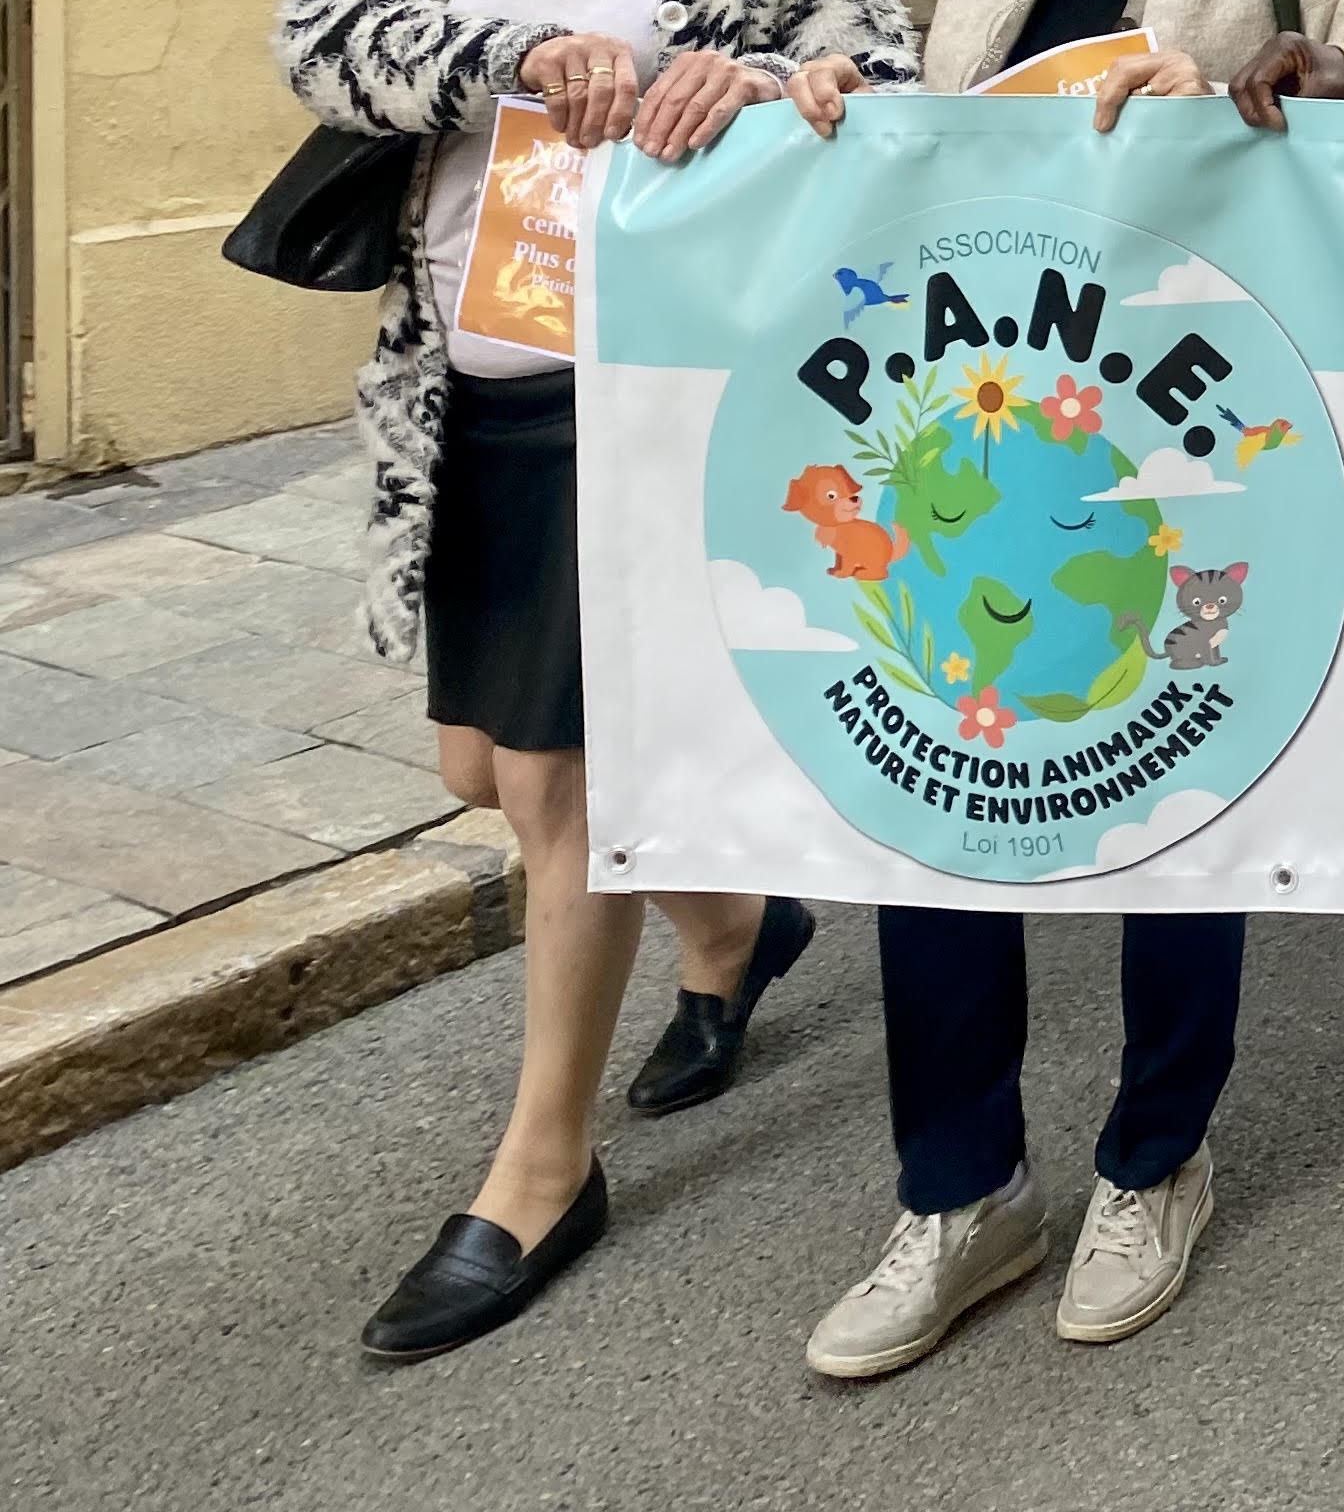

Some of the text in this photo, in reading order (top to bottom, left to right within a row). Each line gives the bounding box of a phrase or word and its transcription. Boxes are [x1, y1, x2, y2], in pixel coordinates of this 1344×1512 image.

[513, 240, 560, 269] Plus
[918, 229, 1103, 274] ASSOCIATION
[796, 267, 1233, 458] P.A.N.E.
[822, 679, 1236, 826] NATURE ET ENVIRONNEMENT
[851, 664, 1206, 789] PROTECTION ANIMAUX,
[961, 831, 1065, 857] Loi 1901
